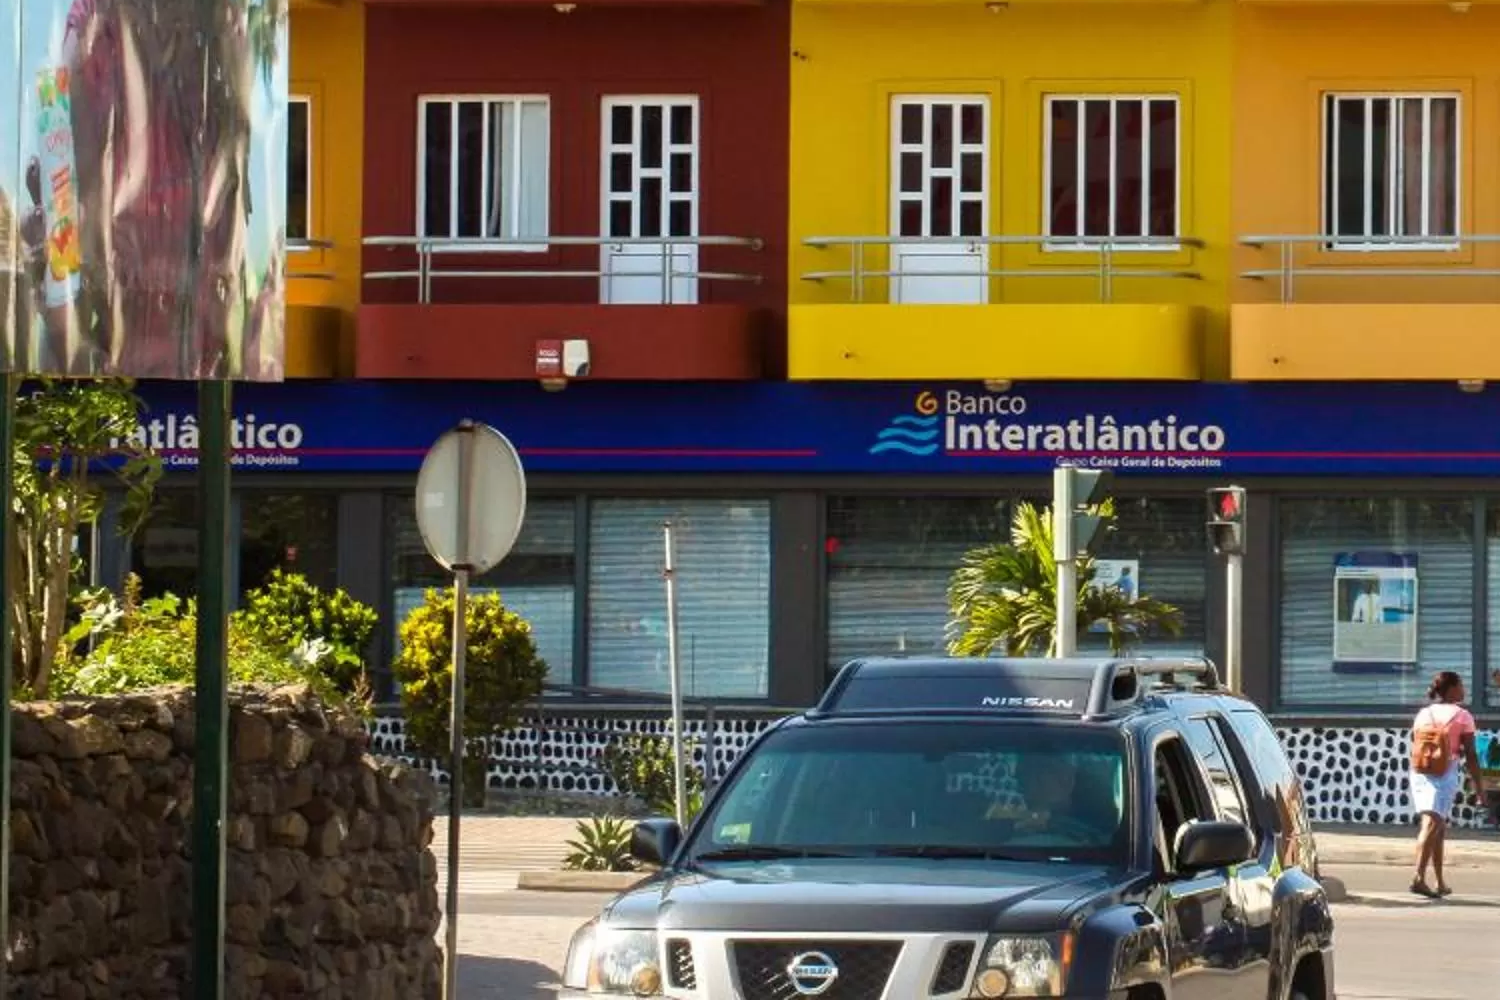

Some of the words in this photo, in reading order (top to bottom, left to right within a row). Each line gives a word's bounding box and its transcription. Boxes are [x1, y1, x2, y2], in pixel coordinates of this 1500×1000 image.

[946, 390, 1027, 415] Banco
[945, 414, 1225, 451] Interatlântico
[1089, 456, 1119, 467] Caixa
[1121, 456, 1150, 467] Geral
[1152, 456, 1164, 467] de
[1167, 456, 1222, 469] Depósitos
[981, 696, 1074, 708] NISSAN
